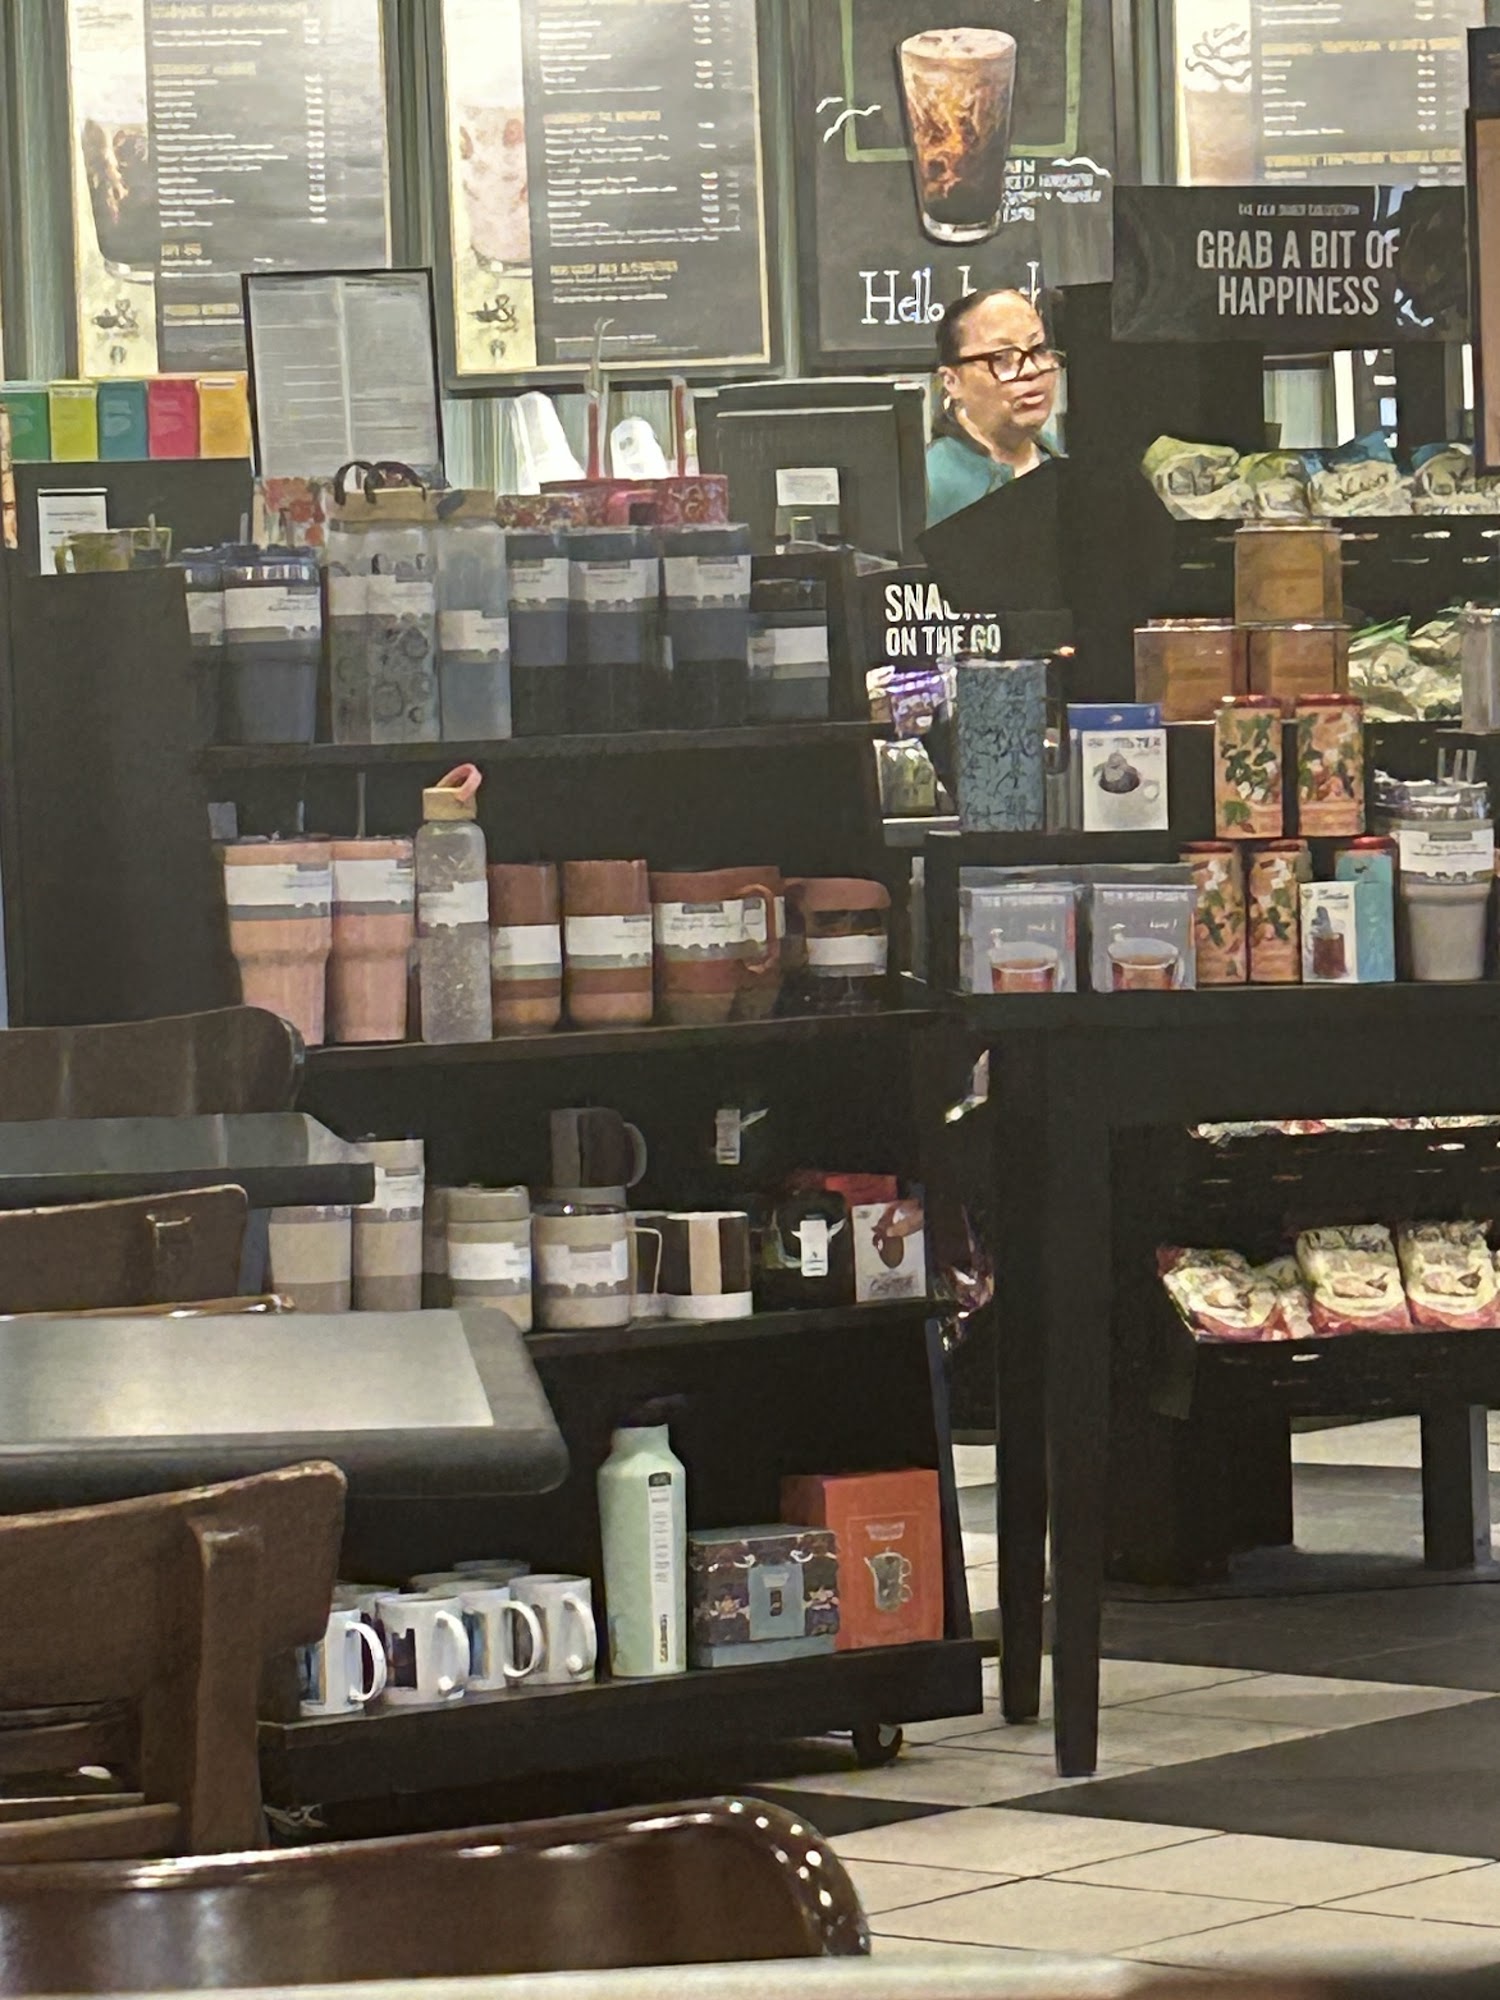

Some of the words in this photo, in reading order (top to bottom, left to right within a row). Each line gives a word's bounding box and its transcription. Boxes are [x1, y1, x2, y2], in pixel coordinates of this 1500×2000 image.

[1197, 230, 1273, 269] GRAB
[1282, 230, 1301, 269] A
[1310, 230, 1356, 269] BIT
[1365, 228, 1400, 269] OF
[858, 267, 945, 325] Hello
[1218, 276, 1380, 316] HAPPINESS
[885, 627, 918, 657] ON
[922, 625, 965, 657] THE
